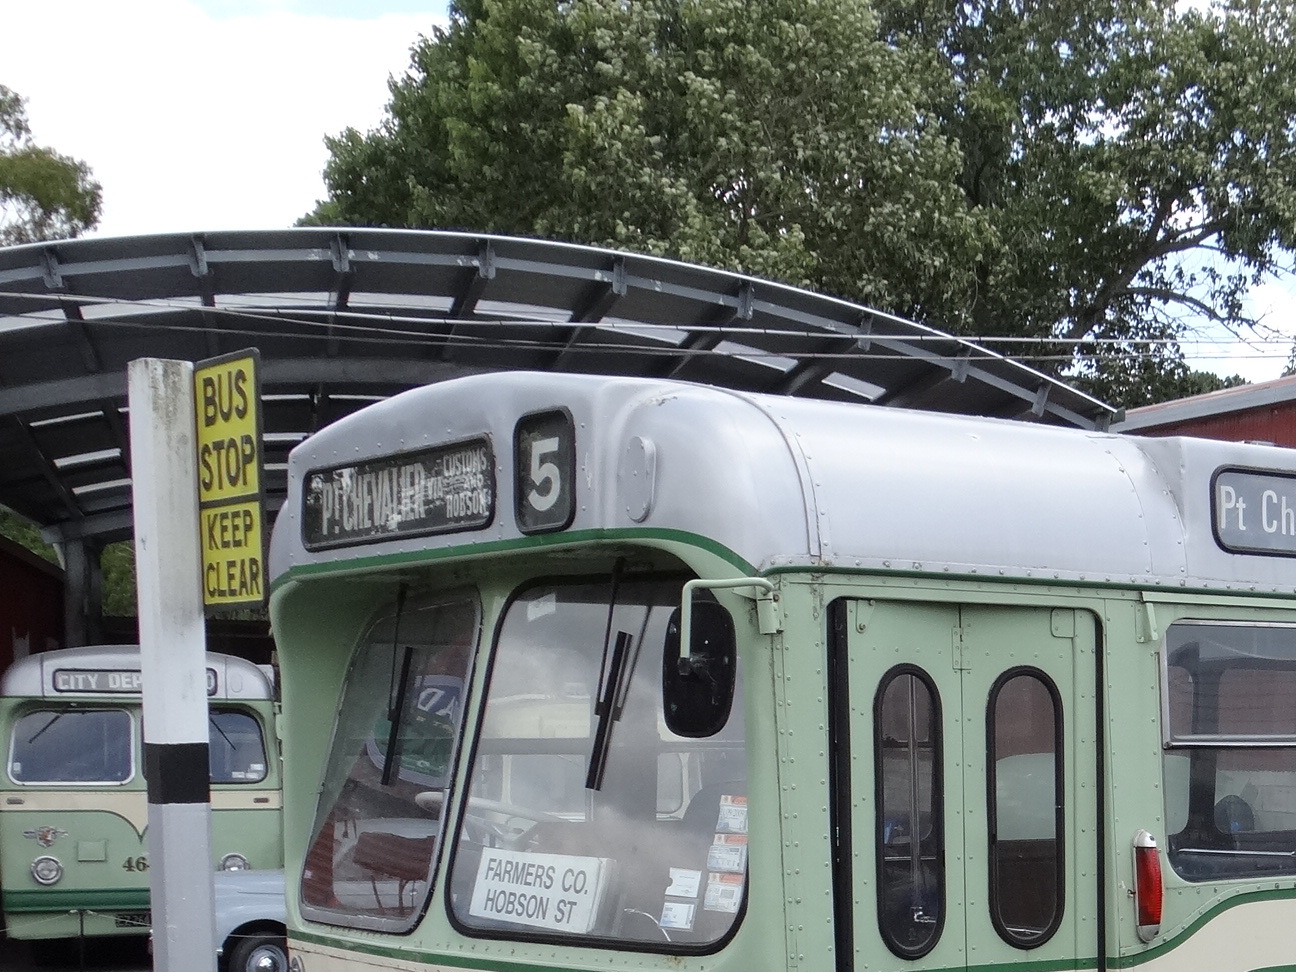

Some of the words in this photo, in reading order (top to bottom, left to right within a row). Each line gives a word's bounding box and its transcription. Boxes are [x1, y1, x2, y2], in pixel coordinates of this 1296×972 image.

[203, 369, 248, 427] BUS
[201, 434, 255, 492] STOP
[443, 448, 487, 477] CUSTOMS
[527, 437, 561, 511] 5
[342, 462, 427, 533] CHEVALIER
[446, 488, 488, 518] HOBSON
[1220, 485, 1247, 531] Pt
[207, 509, 253, 550] KEEP
[205, 557, 261, 598] CLEAR
[58, 674, 99, 690] CITY
[485, 858, 556, 889] FARMERS
[562, 868, 588, 895] CO.
[484, 889, 549, 920] HOBSON
[554, 899, 577, 924] ST
